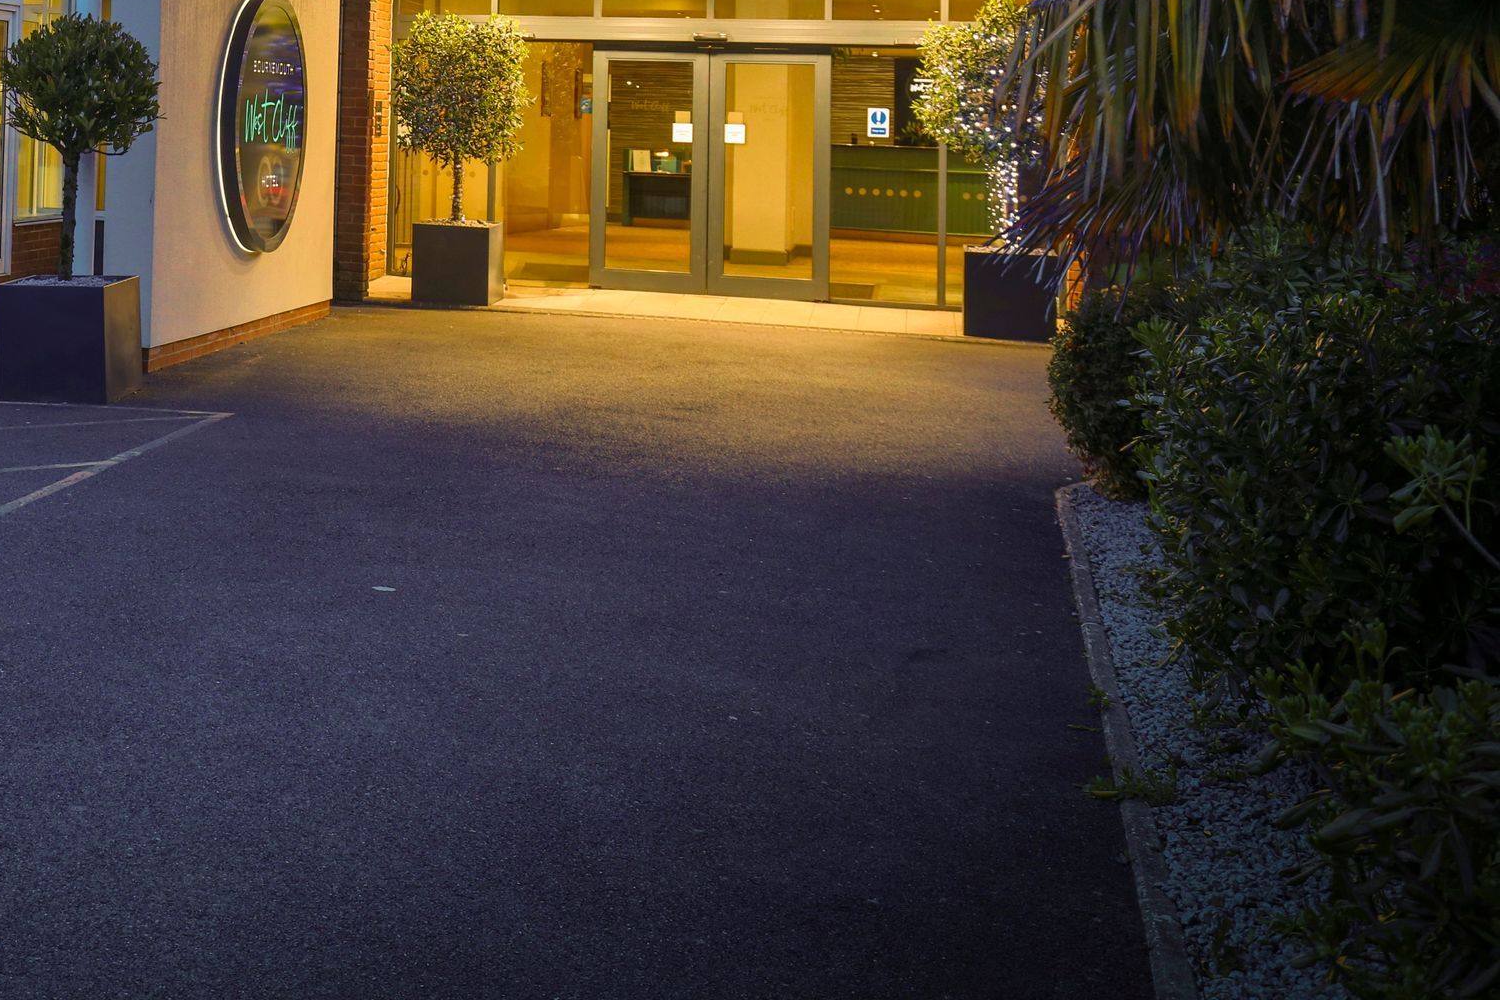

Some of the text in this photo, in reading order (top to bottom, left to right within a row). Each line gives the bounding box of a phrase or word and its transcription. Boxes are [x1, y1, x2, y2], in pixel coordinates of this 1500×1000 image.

[253, 60, 294, 76] BOURNEMOUTH
[244, 87, 299, 154] West Cliff
[261, 174, 279, 188] HOTEL
